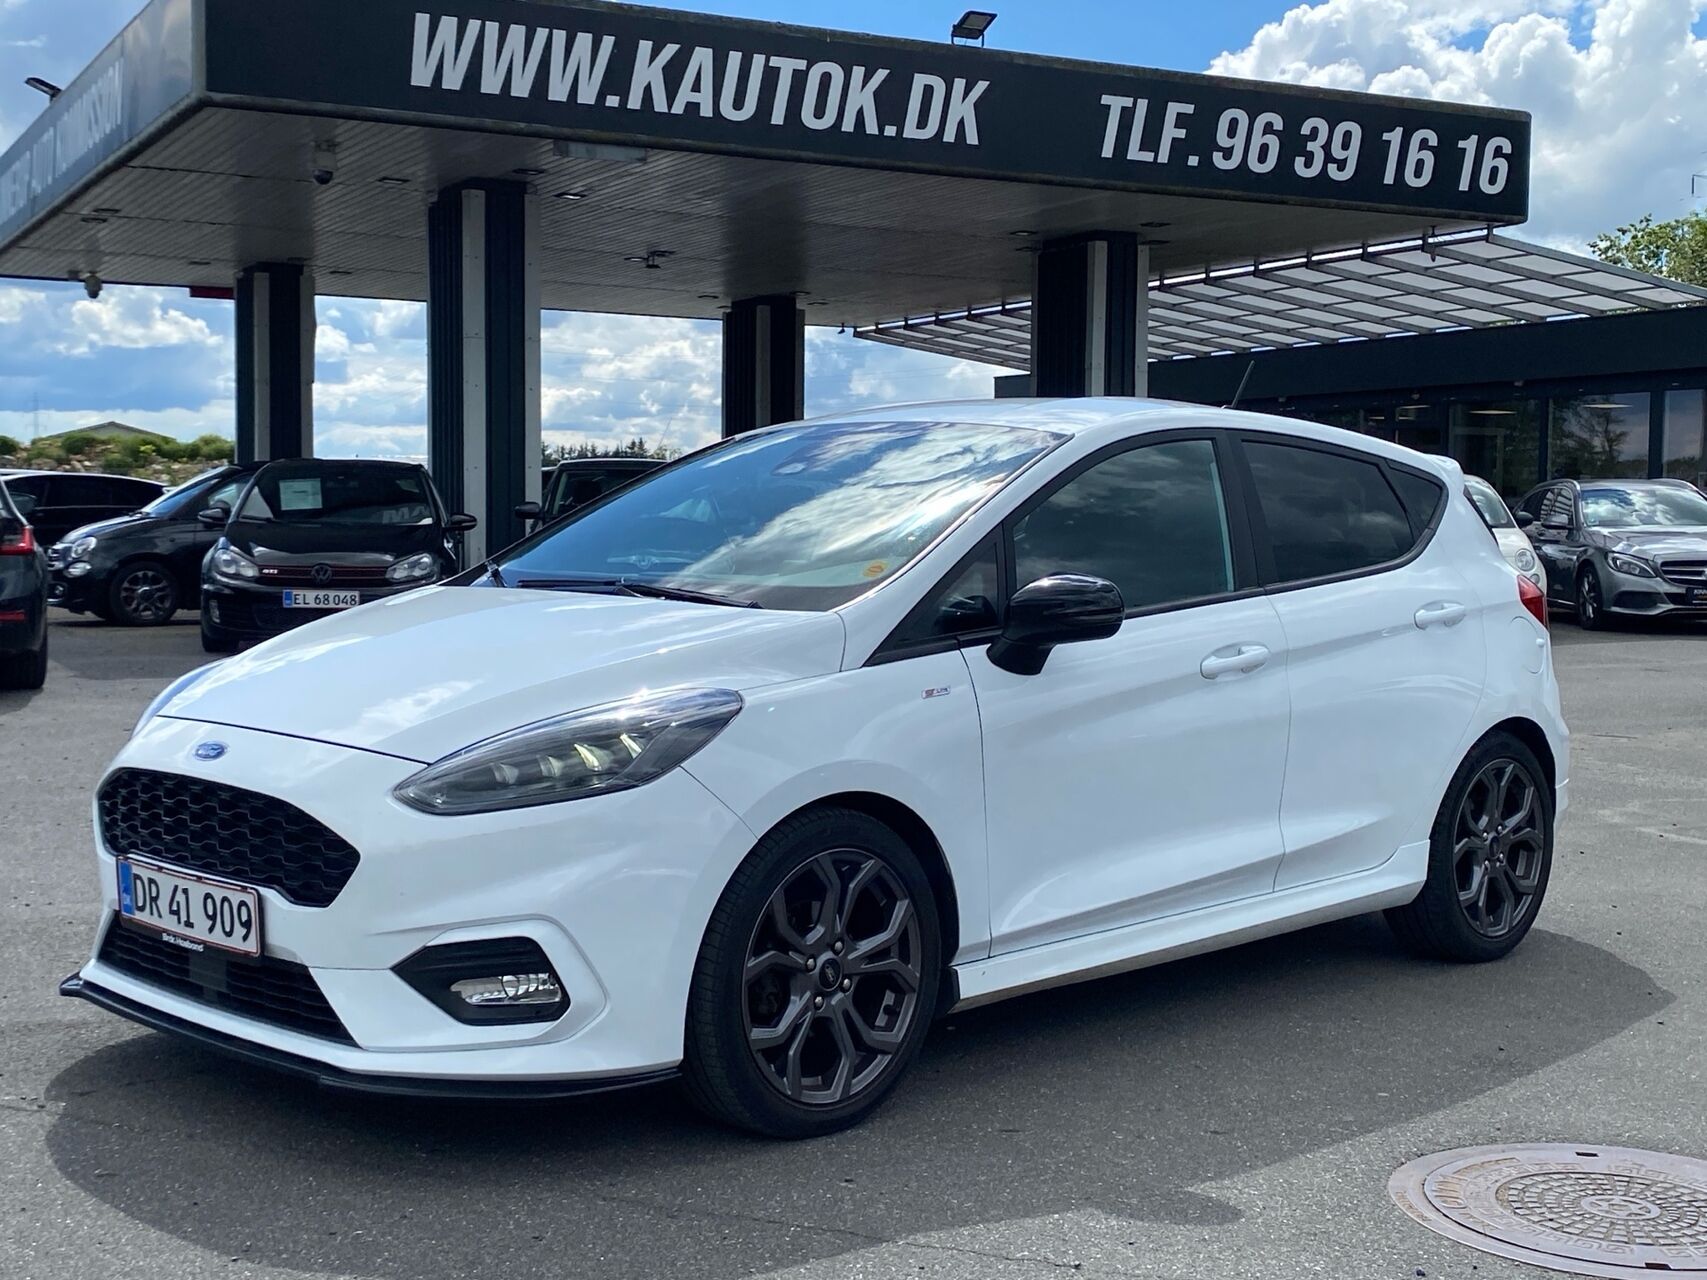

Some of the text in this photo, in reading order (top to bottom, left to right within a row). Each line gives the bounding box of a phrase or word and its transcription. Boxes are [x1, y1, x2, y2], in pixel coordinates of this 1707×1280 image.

[410, 12, 990, 146] WWW.KAUTOK.DK
[1100, 95, 1513, 195] TLF. 96 39 16 16
[293, 593, 357, 606] EL 68 048
[133, 873, 163, 919] DR
[168, 884, 195, 929] 41
[202, 892, 253, 943] 909
